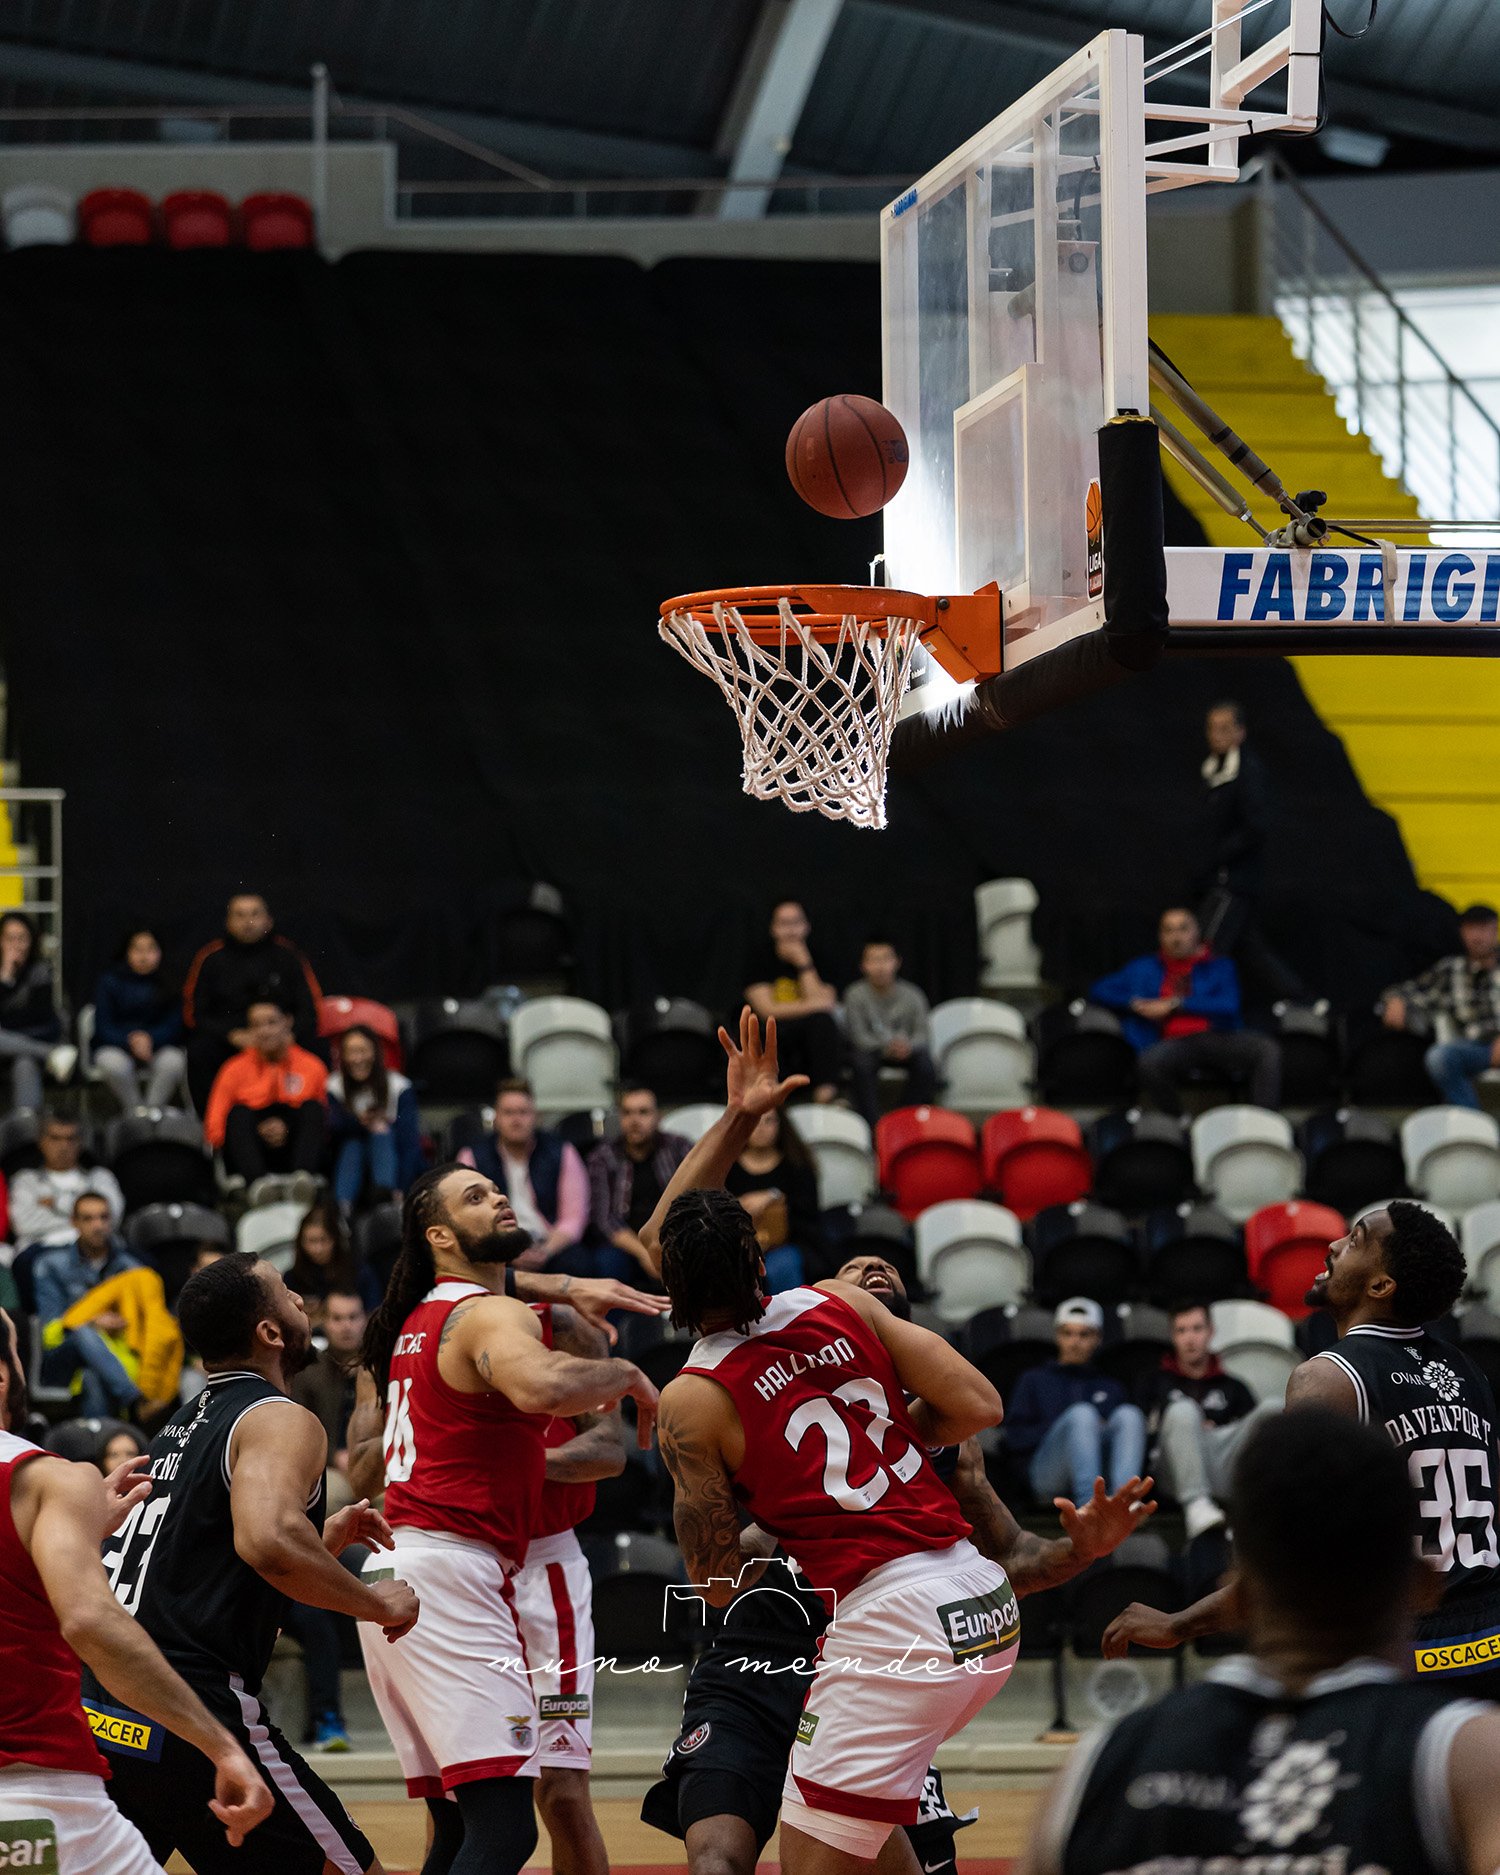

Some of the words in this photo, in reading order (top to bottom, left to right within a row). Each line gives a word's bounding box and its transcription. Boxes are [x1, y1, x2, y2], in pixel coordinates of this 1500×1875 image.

[1391, 1372, 1426, 1386] OVAR
[1385, 1405, 1491, 1448] DAVENPORT
[1407, 1448, 1500, 1572] 35
[1421, 1637, 1500, 1668] OSCACE
